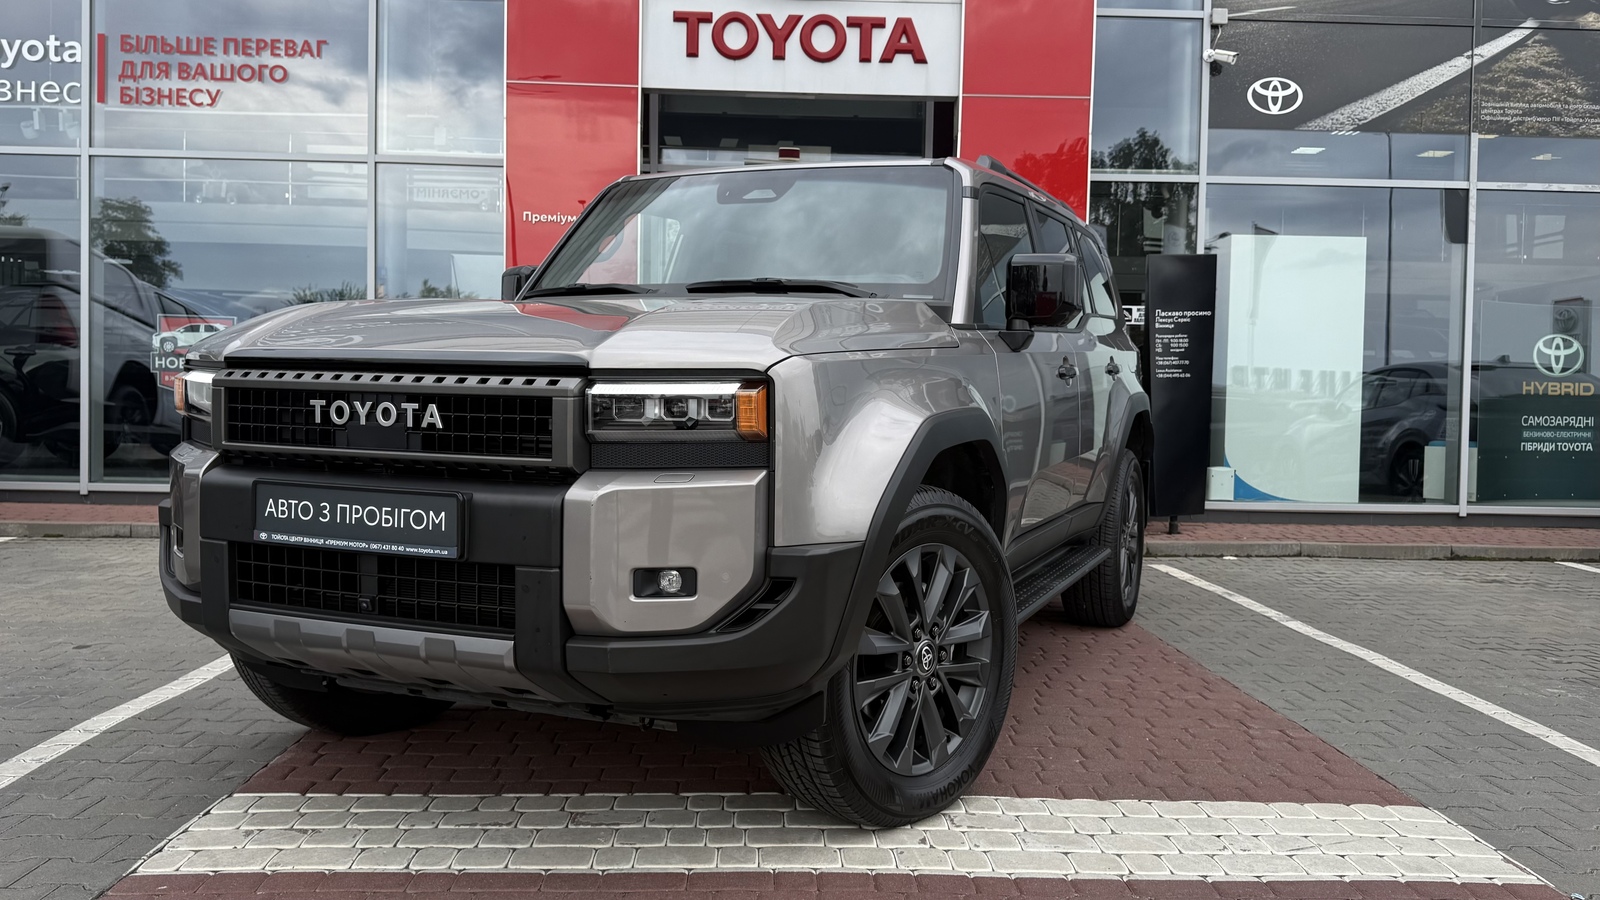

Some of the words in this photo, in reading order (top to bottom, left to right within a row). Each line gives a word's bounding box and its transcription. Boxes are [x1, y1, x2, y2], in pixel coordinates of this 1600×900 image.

[119, 33, 215, 55] БІЛЬШЕ
[222, 37, 328, 58] ПЕРЕВАГ
[673, 10, 928, 64] TOYOTA
[0, 34, 81, 69] yota
[118, 60, 170, 82] ДЛЯ
[177, 62, 288, 83] ВАШОГО
[119, 86, 221, 107] БІЗНЕСУ
[523, 211, 577, 225] Преміум
[1155, 309, 1183, 317] Ласкаво
[1184, 310, 1211, 318] просимо
[1522, 381, 1595, 396] HYBRID
[309, 399, 443, 429] TOYOTA
[1521, 415, 1594, 428] САМОЗАРЯДНІ
[1520, 442, 1555, 453] ГІБРИДИ
[1556, 442, 1593, 452] TOYOTA
[264, 498, 313, 521] АВТО
[318, 502, 331, 522] З
[336, 503, 446, 532] ПРОБІГОМ
[405, 546, 448, 555] www.toyota.vn.ua
